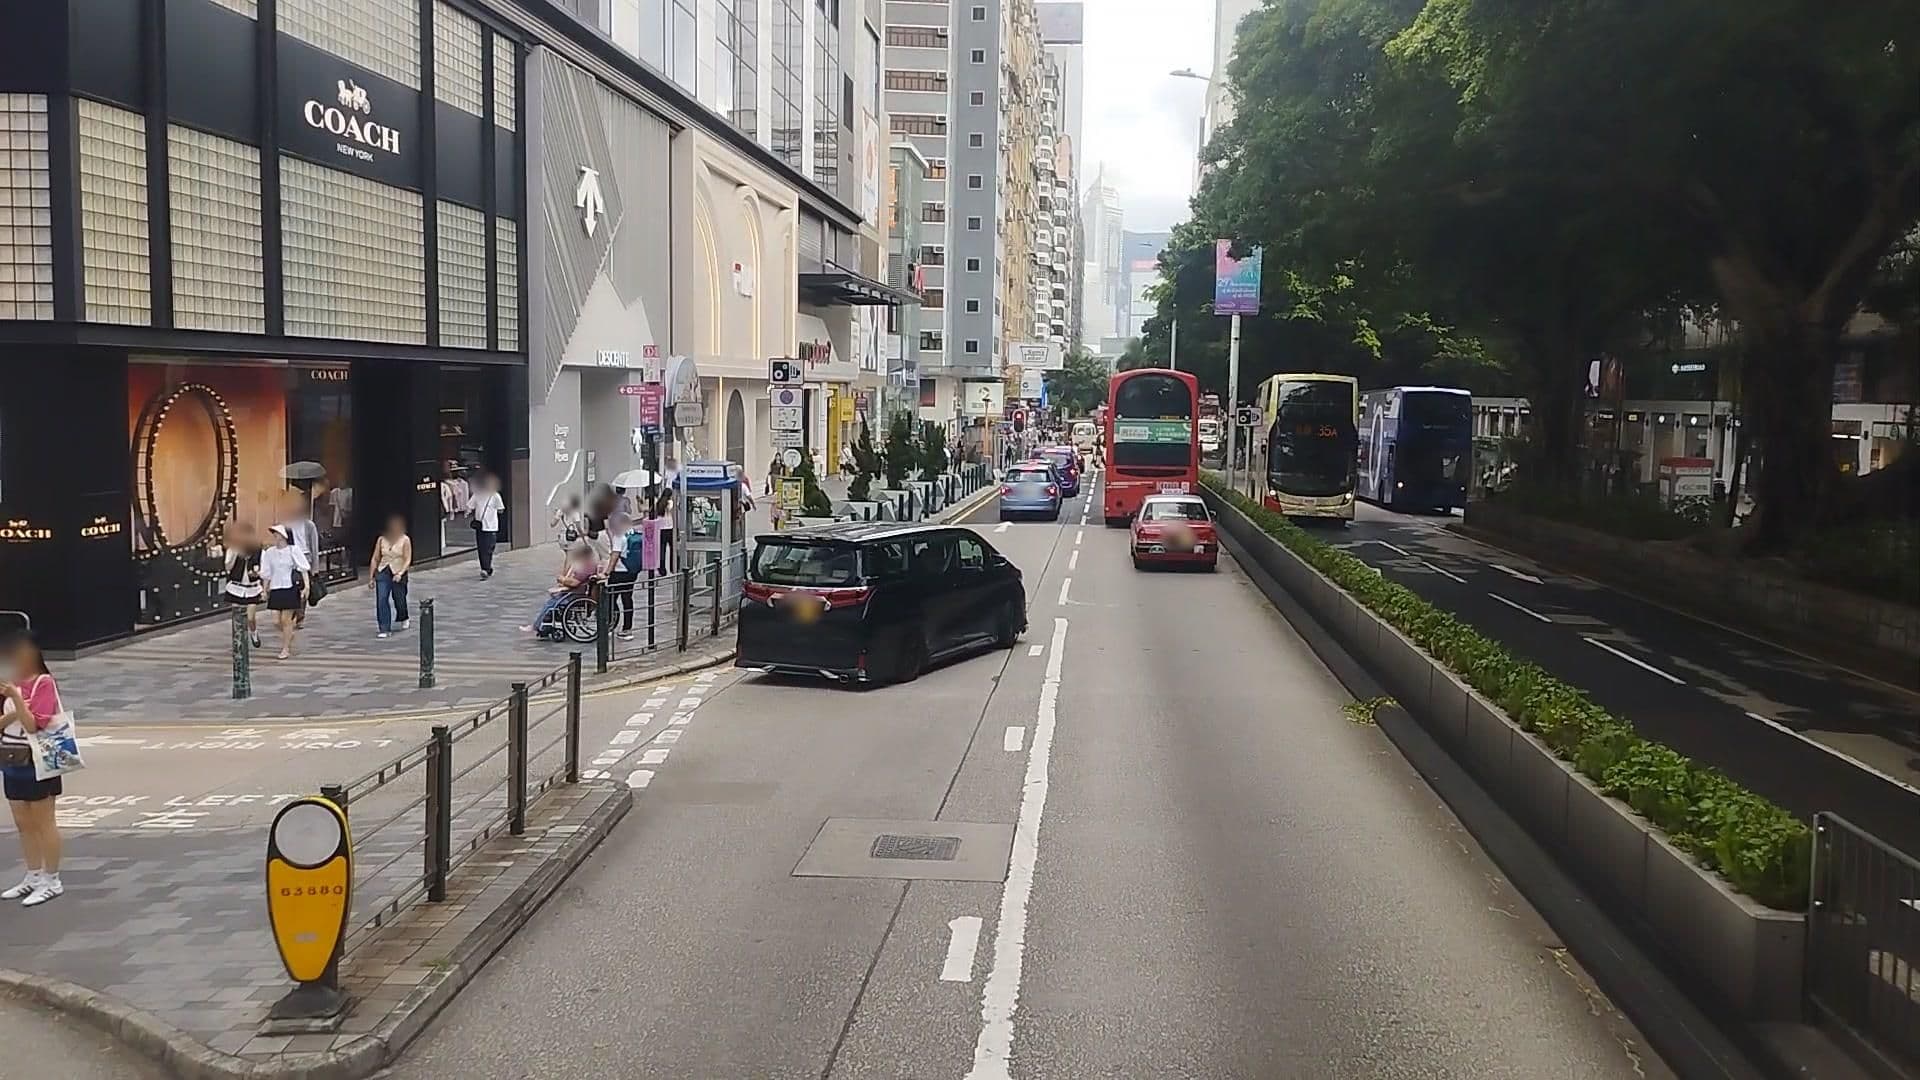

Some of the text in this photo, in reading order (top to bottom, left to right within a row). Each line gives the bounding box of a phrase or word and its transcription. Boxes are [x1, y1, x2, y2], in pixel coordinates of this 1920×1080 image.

[304, 100, 400, 155] COACH
[337, 143, 374, 162] NEW YORK
[598, 350, 630, 367] DESCENTE
[311, 369, 348, 380] COACH
[1319, 426, 1338, 438] 35A
[0, 529, 52, 539] OACH
[81, 523, 121, 537] COACH
[140, 740, 392, 750] LOOK RIGHT
[55, 794, 298, 806] OOK LEFT
